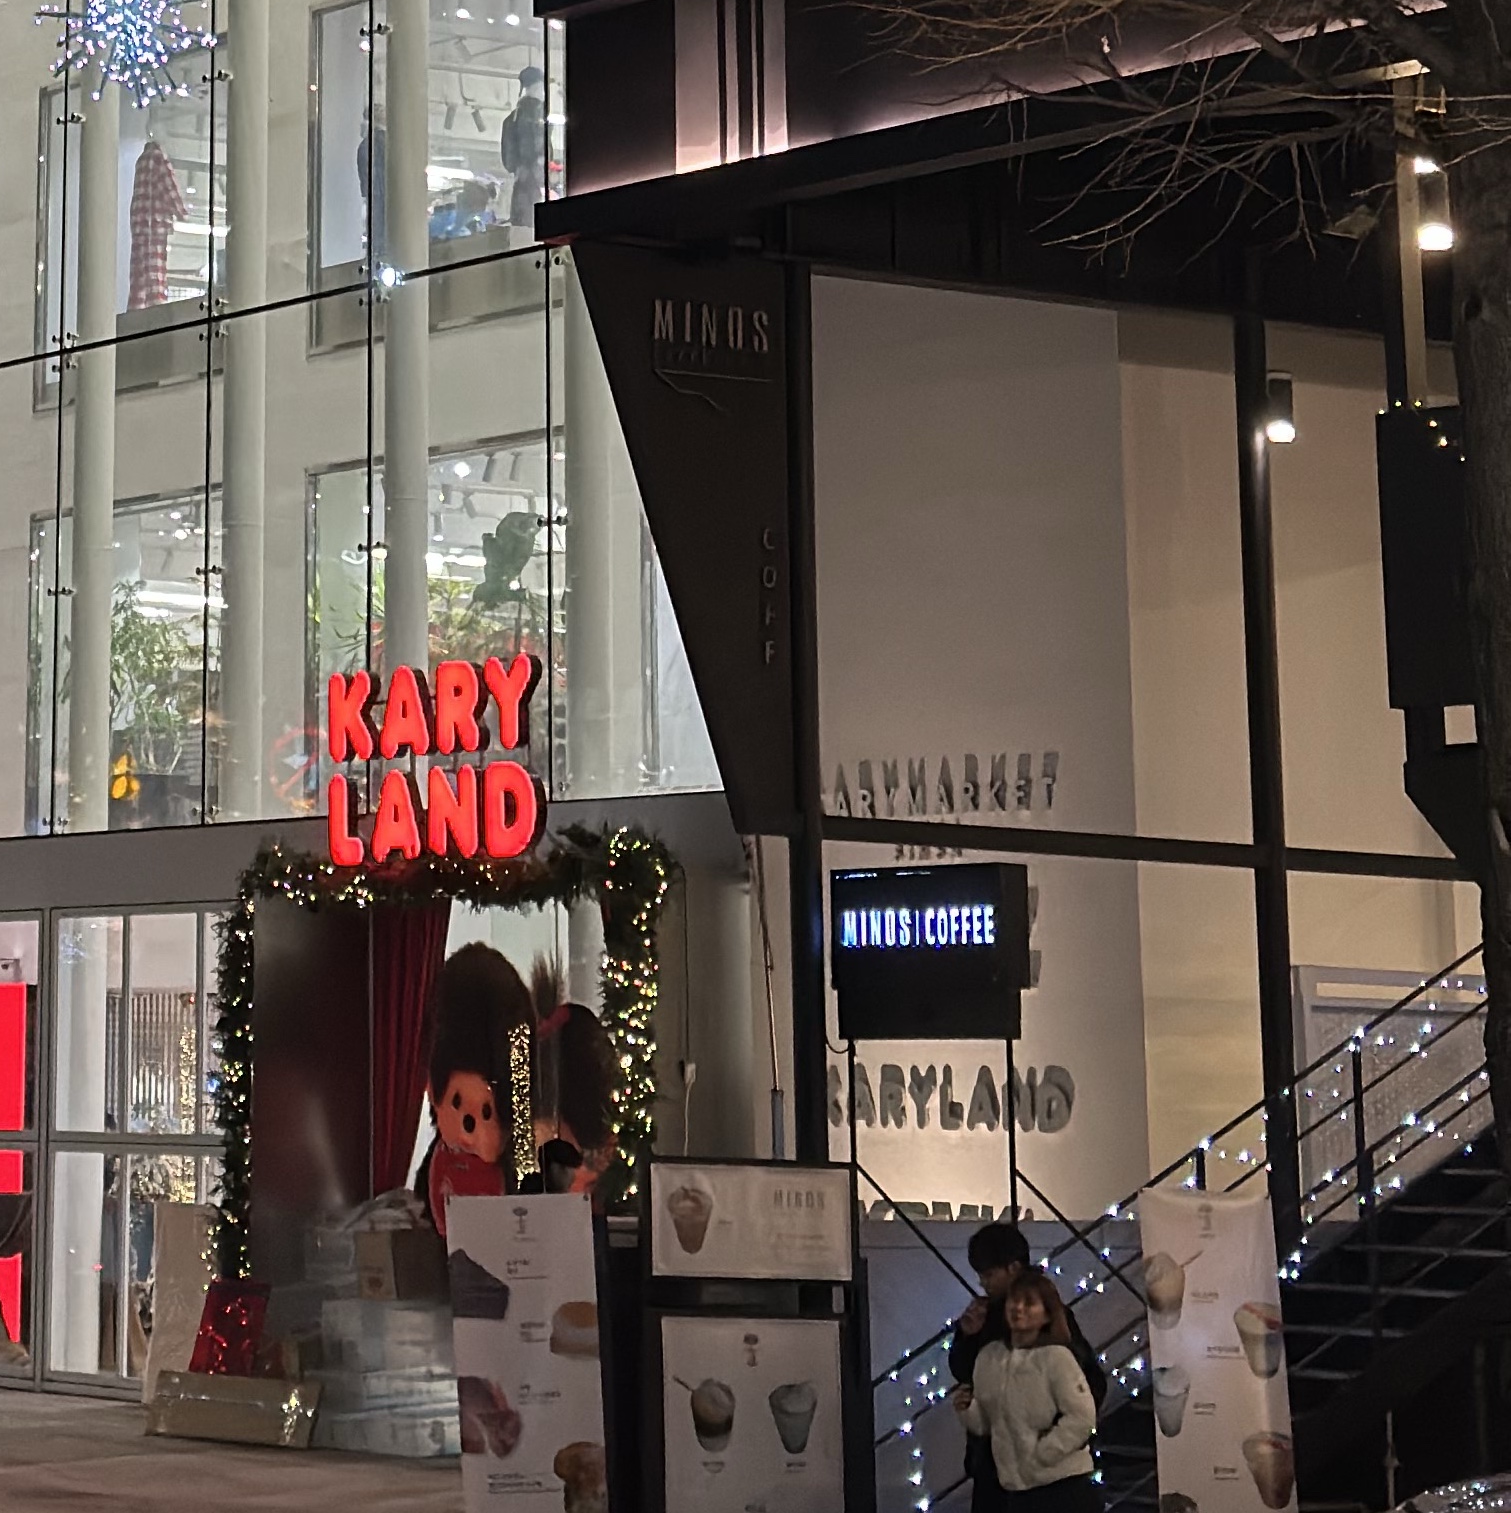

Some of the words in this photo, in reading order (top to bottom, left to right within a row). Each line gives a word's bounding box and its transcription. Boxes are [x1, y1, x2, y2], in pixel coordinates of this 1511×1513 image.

[653, 298, 769, 353] MINOS
[328, 651, 542, 764] KARY
[328, 760, 548, 867] LAND
[823, 752, 1059, 819] ARYMARKET
[843, 909, 911, 946] MINOS
[925, 904, 995, 945] COFFEE
